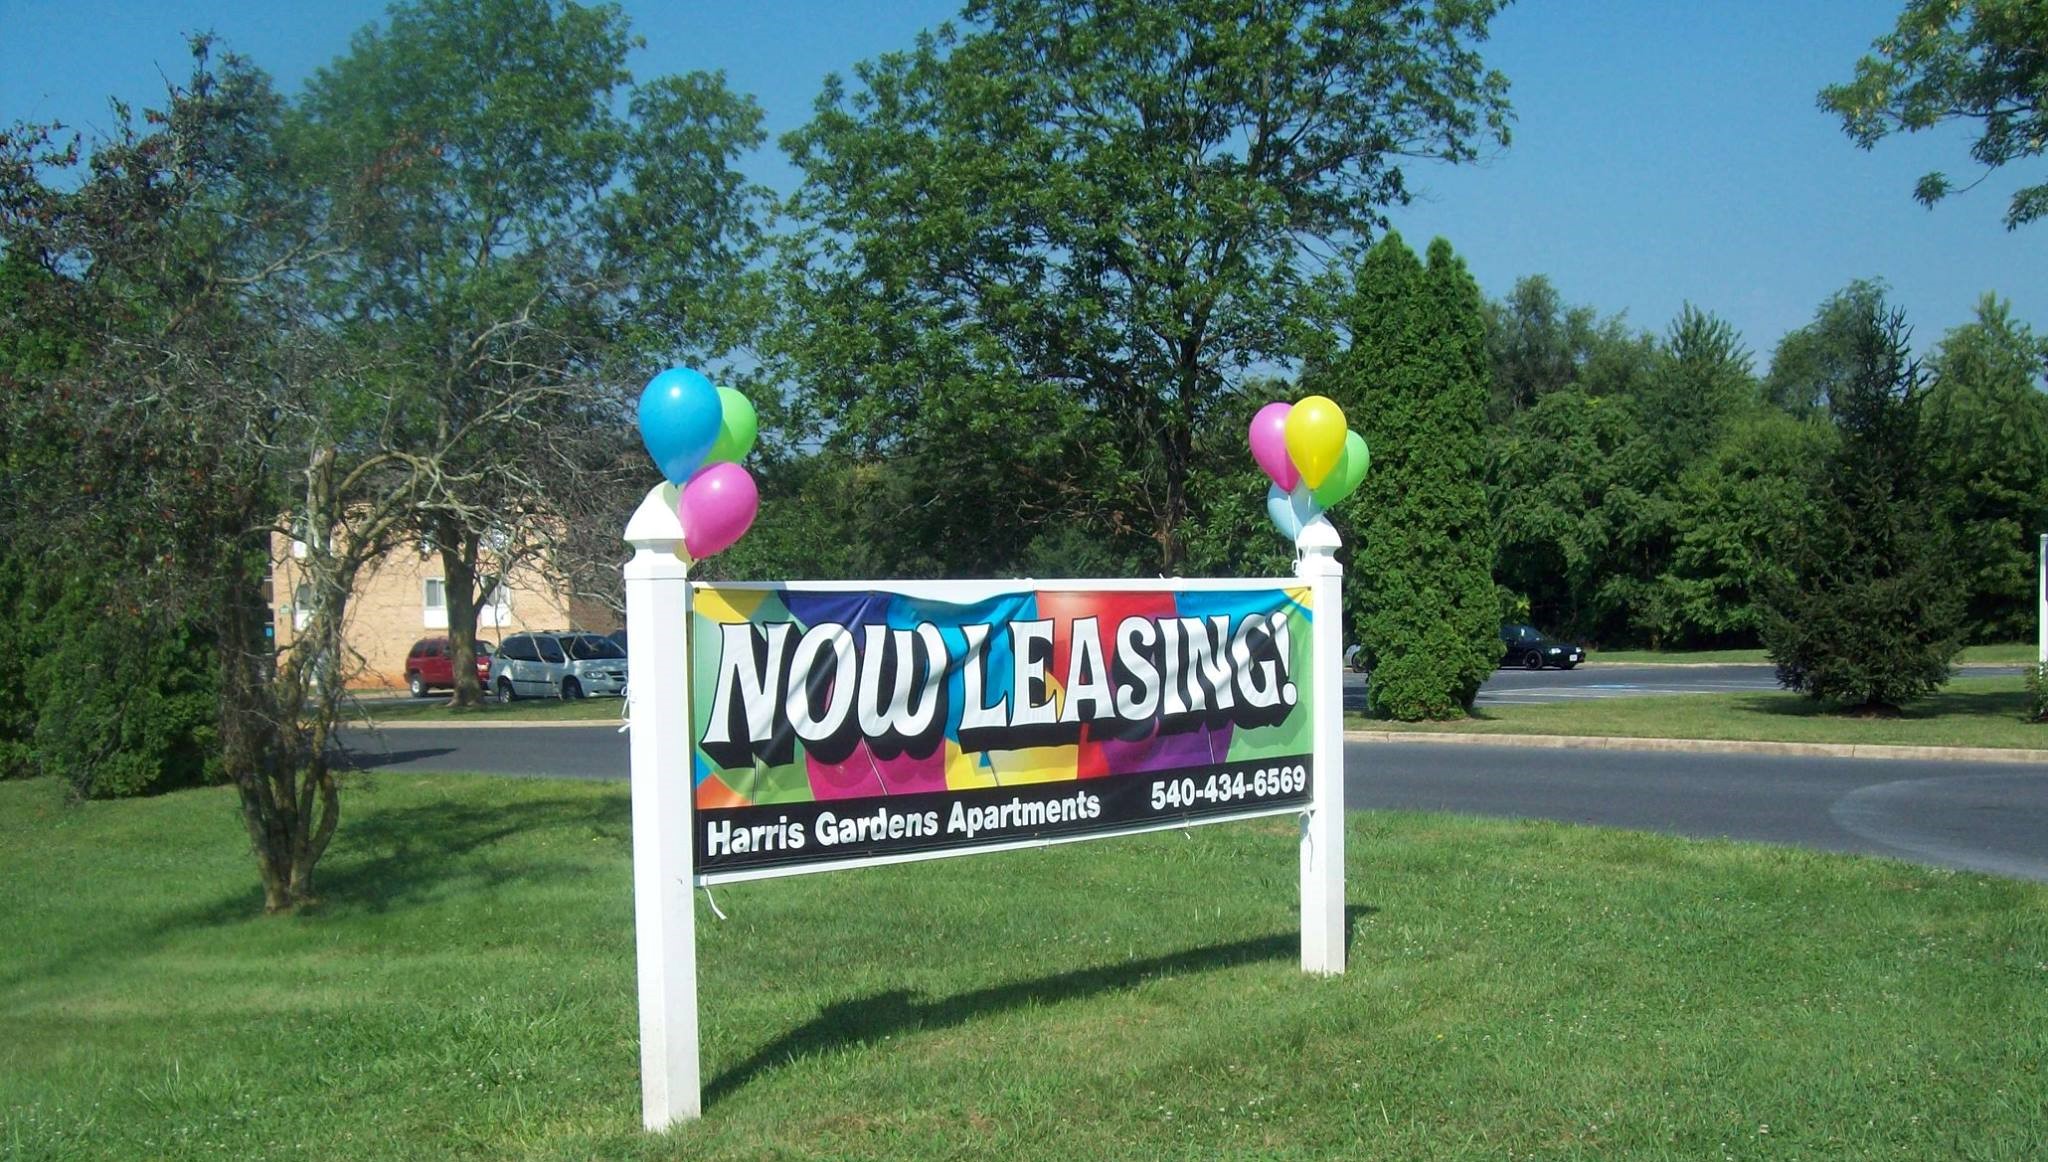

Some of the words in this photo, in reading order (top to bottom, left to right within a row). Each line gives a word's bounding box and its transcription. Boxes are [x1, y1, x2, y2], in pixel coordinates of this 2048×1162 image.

[701, 621, 948, 744] NOW
[958, 611, 1298, 731] LEASING!
[1150, 764, 1306, 811] 540-434-6569
[707, 815, 806, 857] Harris
[814, 807, 939, 846] Gardens
[946, 790, 1101, 838] Apartments
